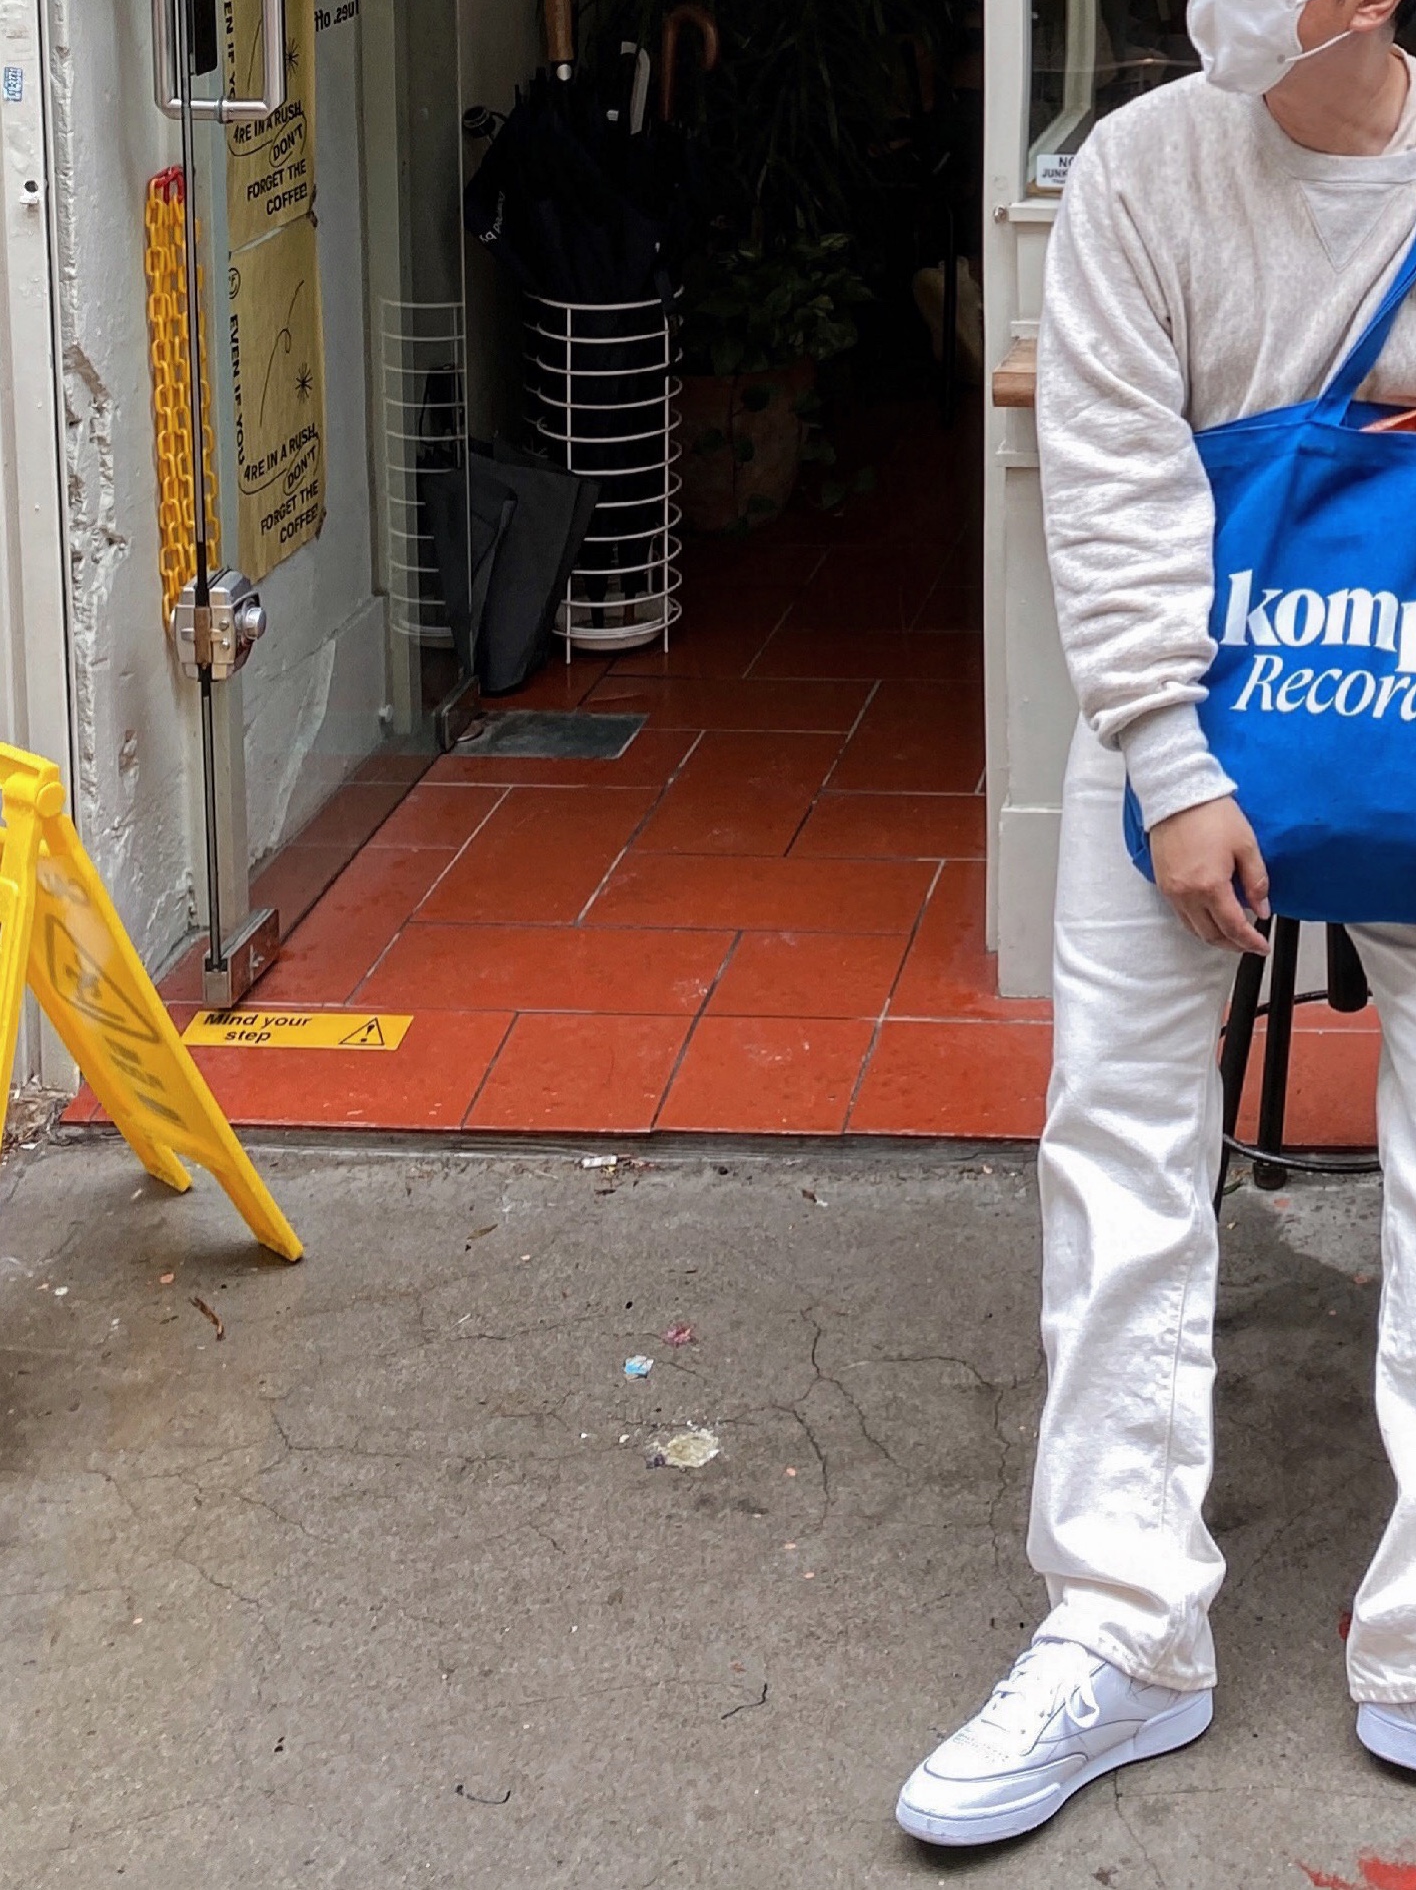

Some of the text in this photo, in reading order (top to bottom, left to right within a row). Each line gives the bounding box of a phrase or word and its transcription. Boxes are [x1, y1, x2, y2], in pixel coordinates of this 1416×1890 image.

[226, 43, 235, 64] IF
[227, 73, 237, 98] YO
[233, 123, 252, 145] ARE
[254, 120, 265, 138] IN
[266, 113, 273, 131] A
[273, 123, 303, 162] DON'T
[247, 158, 307, 202] FORGET THE
[230, 313, 245, 466] EVEN IF YOU
[244, 458, 265, 483] ARE
[267, 449, 278, 472] IN
[280, 443, 287, 462] A
[287, 443, 316, 490] DON'T
[260, 478, 319, 536] FORGET THE
[204, 1013, 313, 1029] Mind your
[225, 1029, 272, 1044] step
